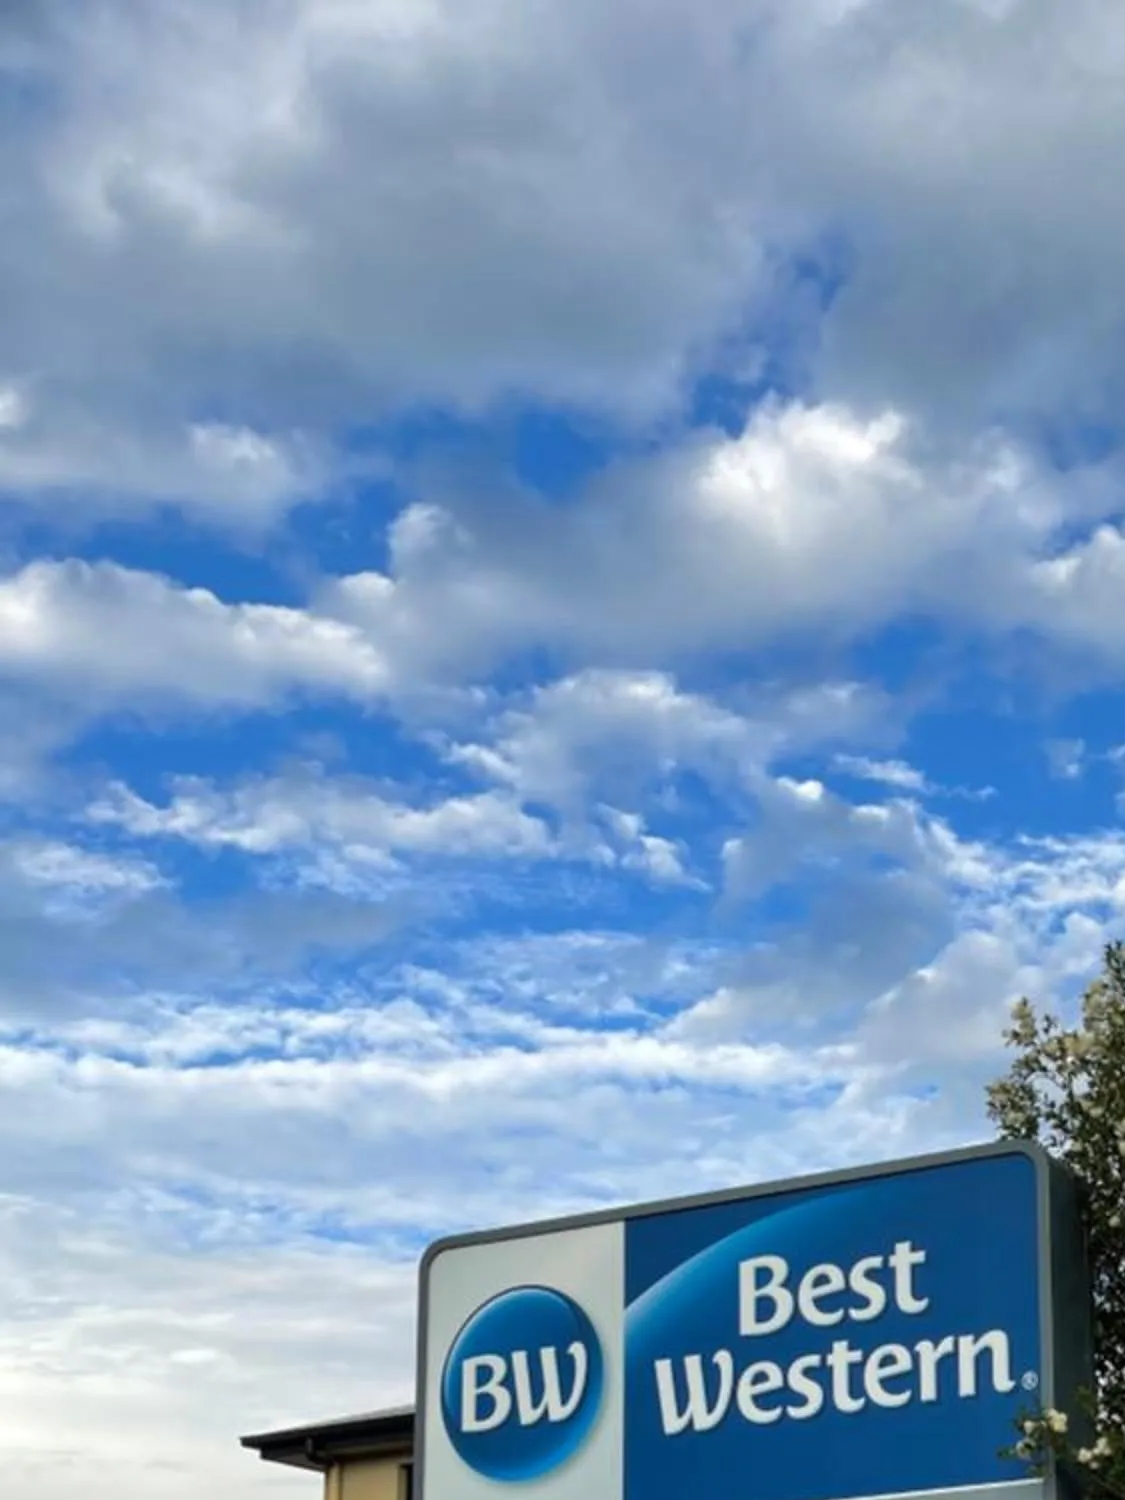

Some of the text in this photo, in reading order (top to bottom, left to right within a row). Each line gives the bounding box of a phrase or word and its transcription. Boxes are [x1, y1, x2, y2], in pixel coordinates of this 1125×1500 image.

[738, 1240, 930, 1337] Best
[460, 1341, 588, 1433] BW
[654, 1330, 1016, 1437] Western
